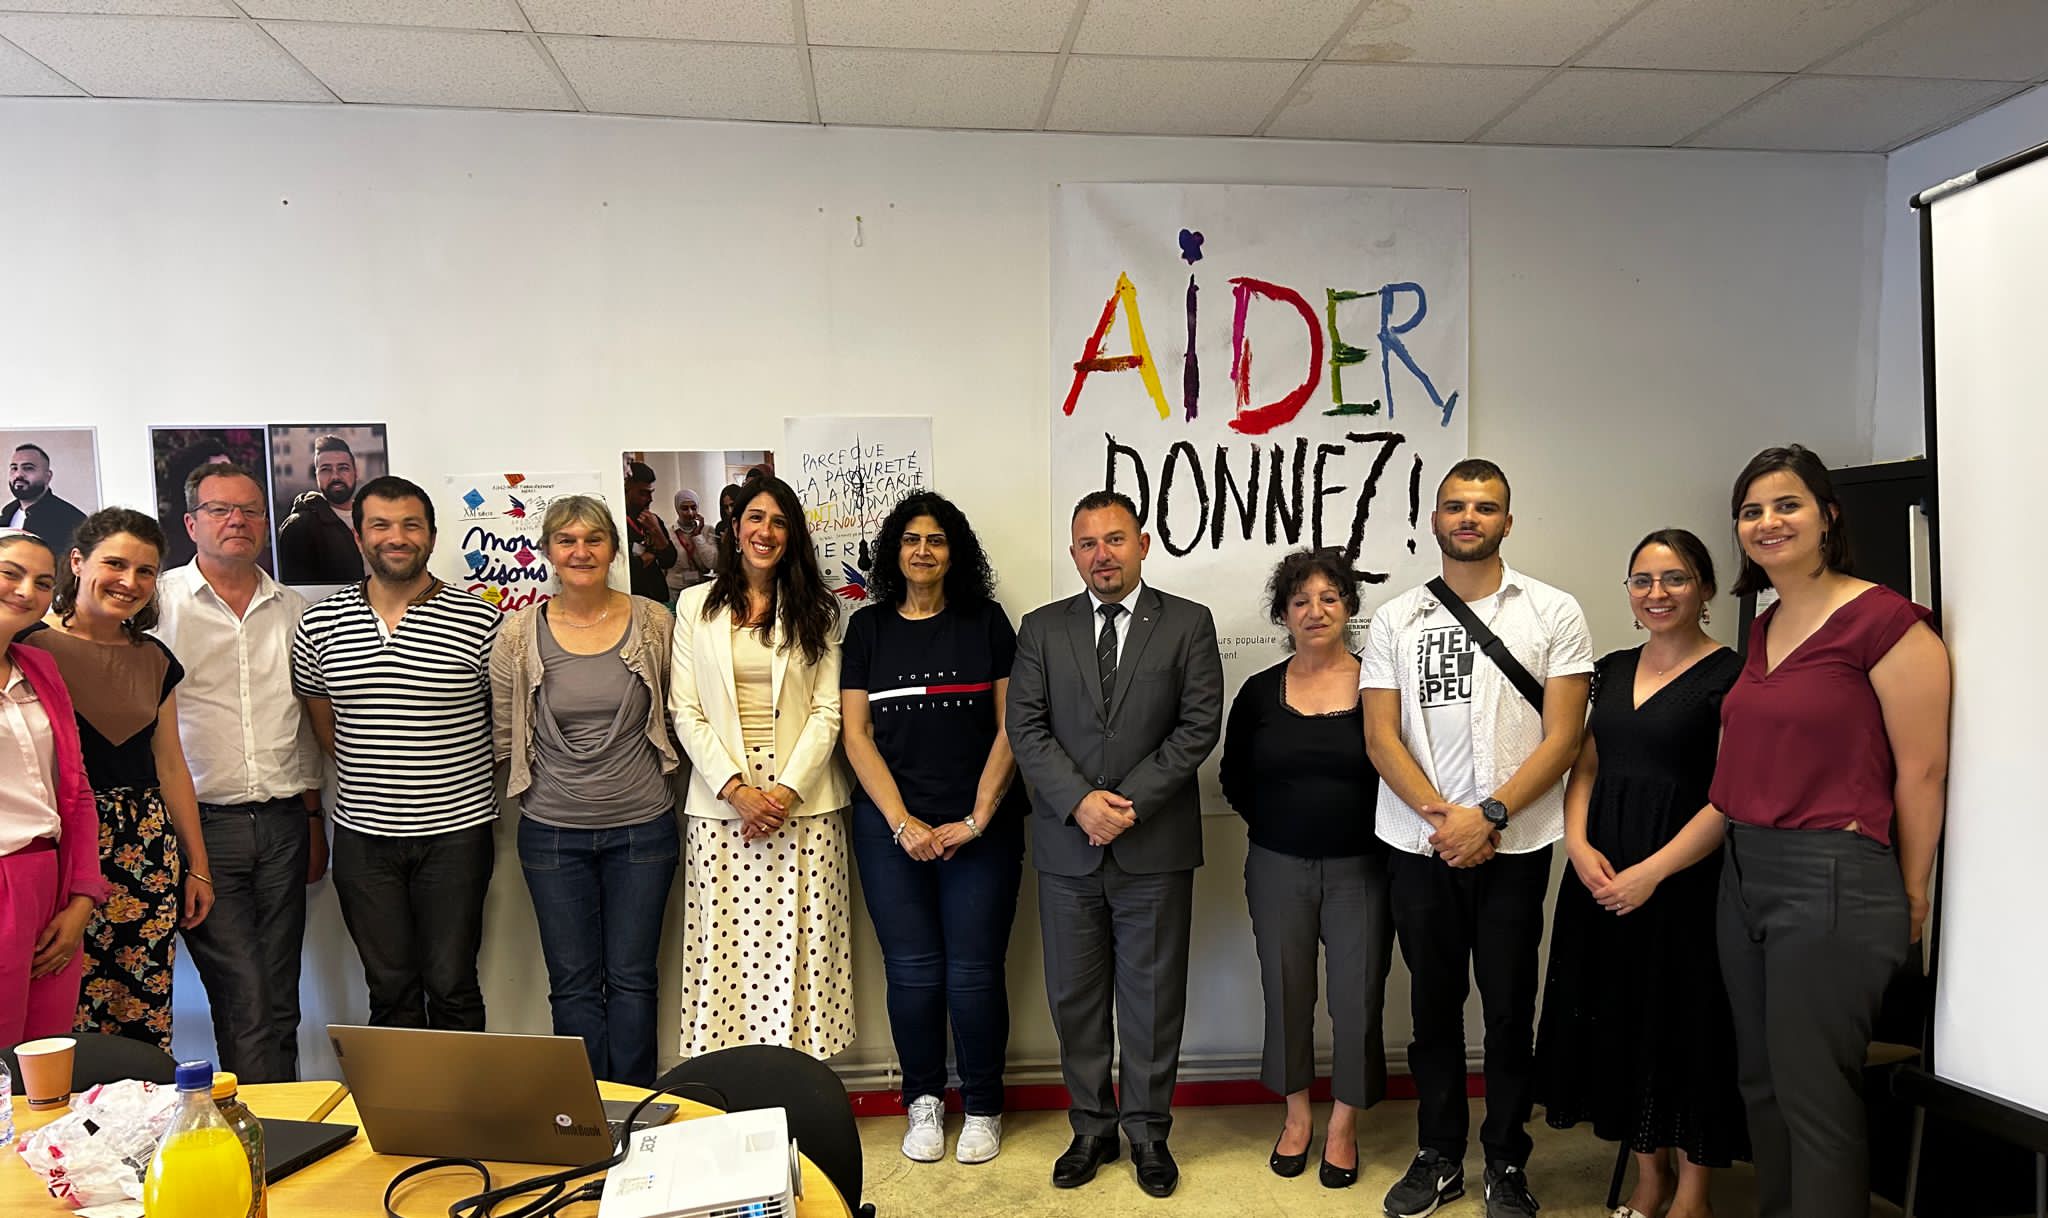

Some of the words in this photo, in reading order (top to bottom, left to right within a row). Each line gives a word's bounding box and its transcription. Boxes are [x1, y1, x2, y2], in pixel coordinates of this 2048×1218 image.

[1235, 635, 1276, 646] populaire
[898, 671, 957, 681] TOMMY
[882, 699, 973, 713] HILFIGER
